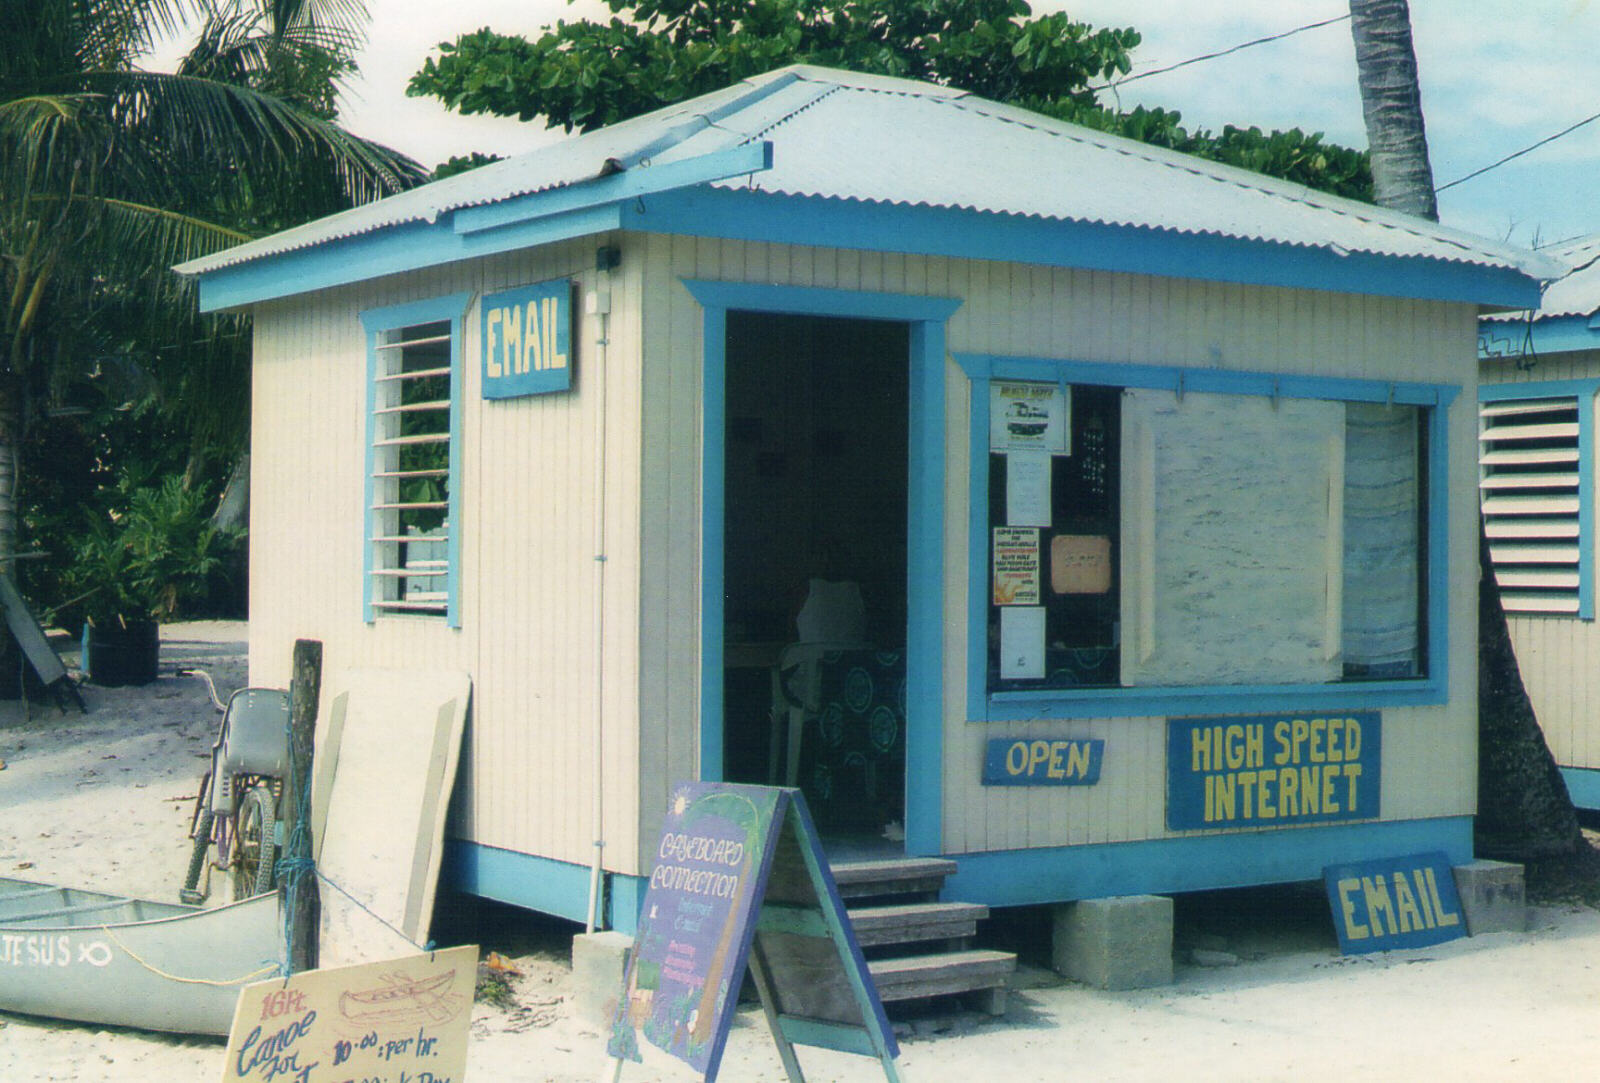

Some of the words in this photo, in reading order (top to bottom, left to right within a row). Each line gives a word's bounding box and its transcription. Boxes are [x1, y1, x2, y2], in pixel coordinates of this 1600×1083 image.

[487, 296, 567, 378] EMAIL
[1005, 740, 1091, 780] OPEN
[1191, 723, 1264, 772] HIGH
[1274, 718, 1362, 765] SPEED
[1204, 763, 1363, 823] INTERNET
[651, 864, 738, 899] CONNECTION
[1337, 866, 1460, 941] EMAIL
[0, 935, 72, 967] JESUS
[237, 1010, 317, 1077] Canoe
[416, 1026, 438, 1058] hr.
